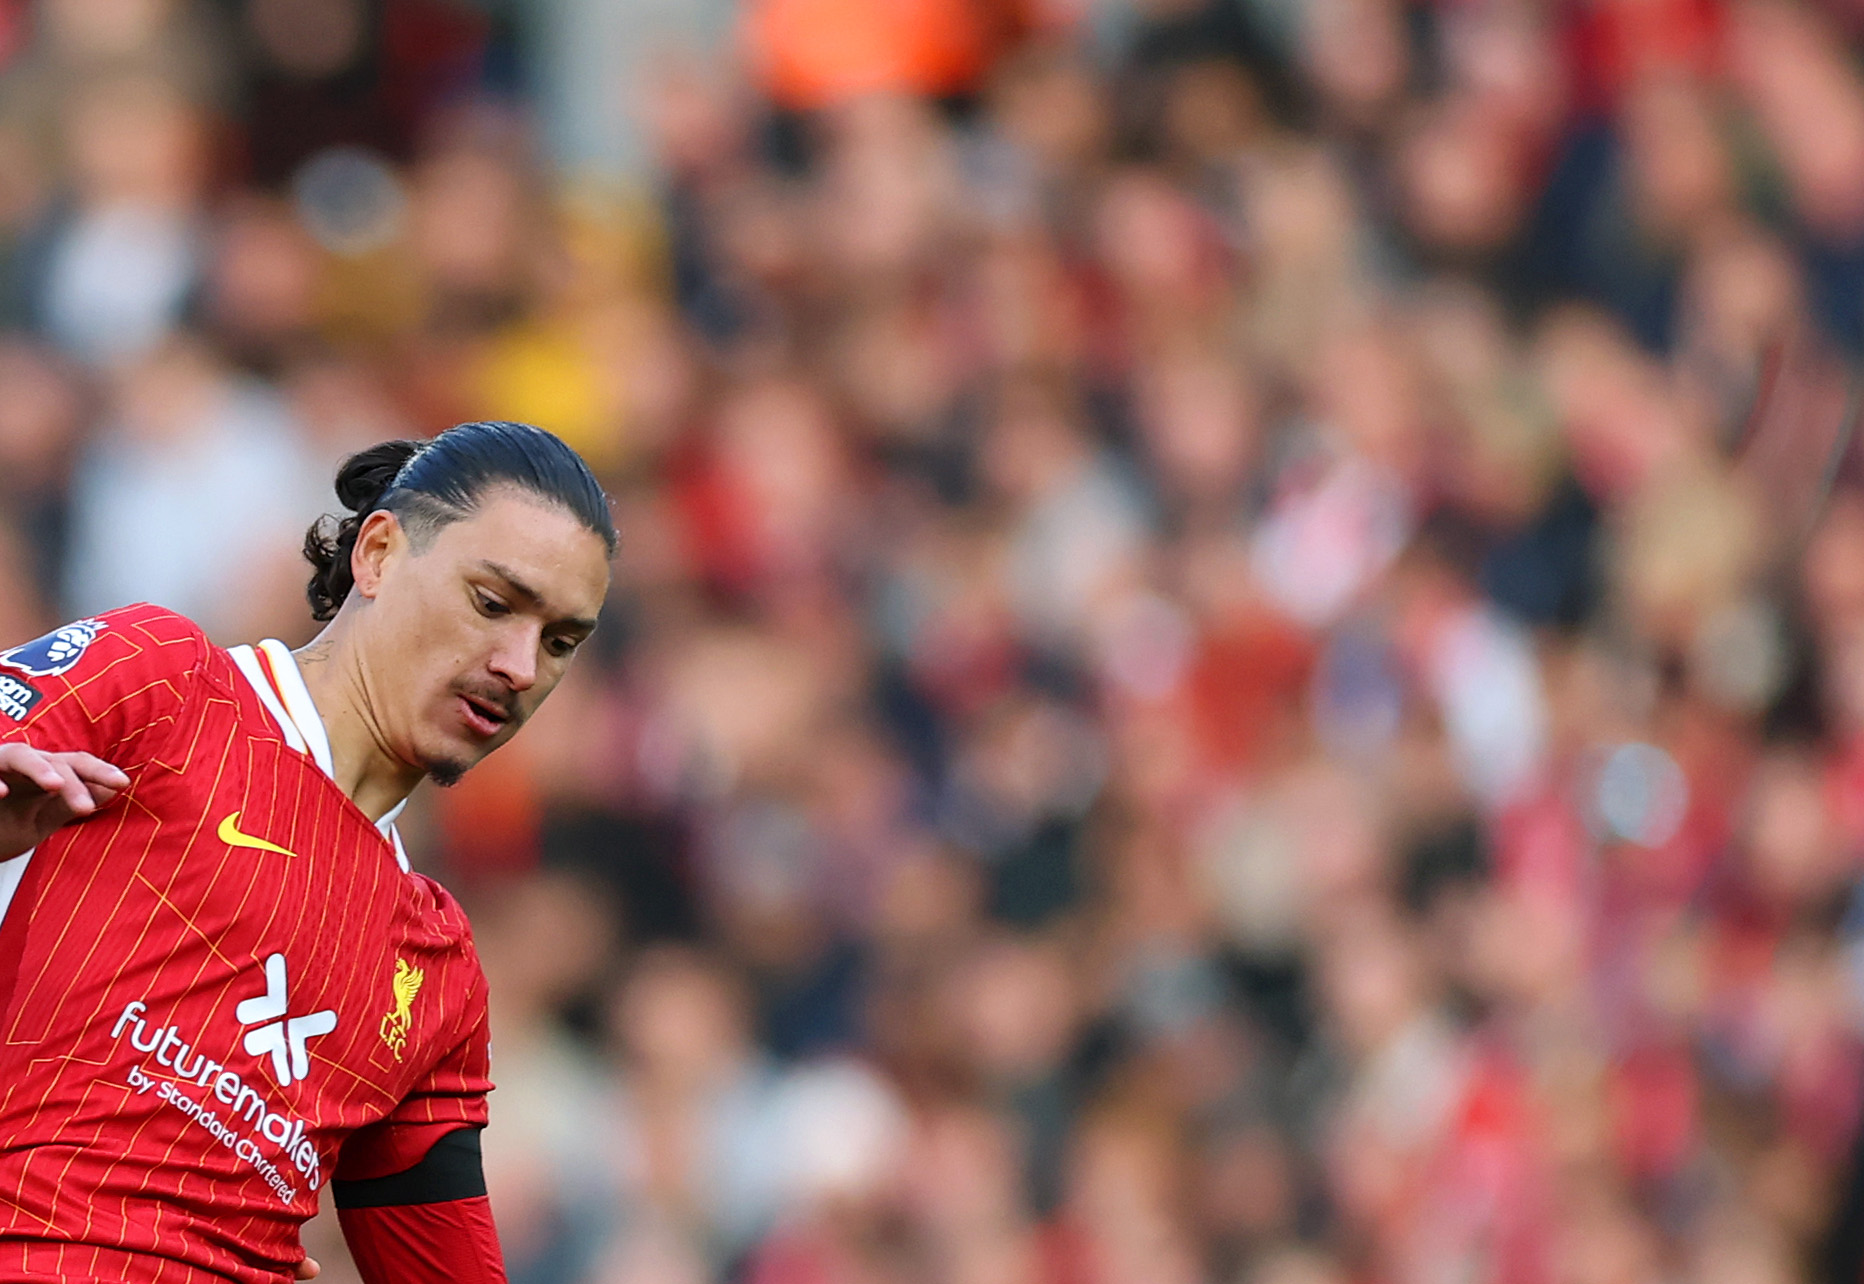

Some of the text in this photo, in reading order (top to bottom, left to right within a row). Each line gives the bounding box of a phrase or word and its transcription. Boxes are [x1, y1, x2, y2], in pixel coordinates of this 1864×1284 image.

[110, 1001, 320, 1191] futuremakers
[126, 1065, 297, 1205] by Standard Chartered
